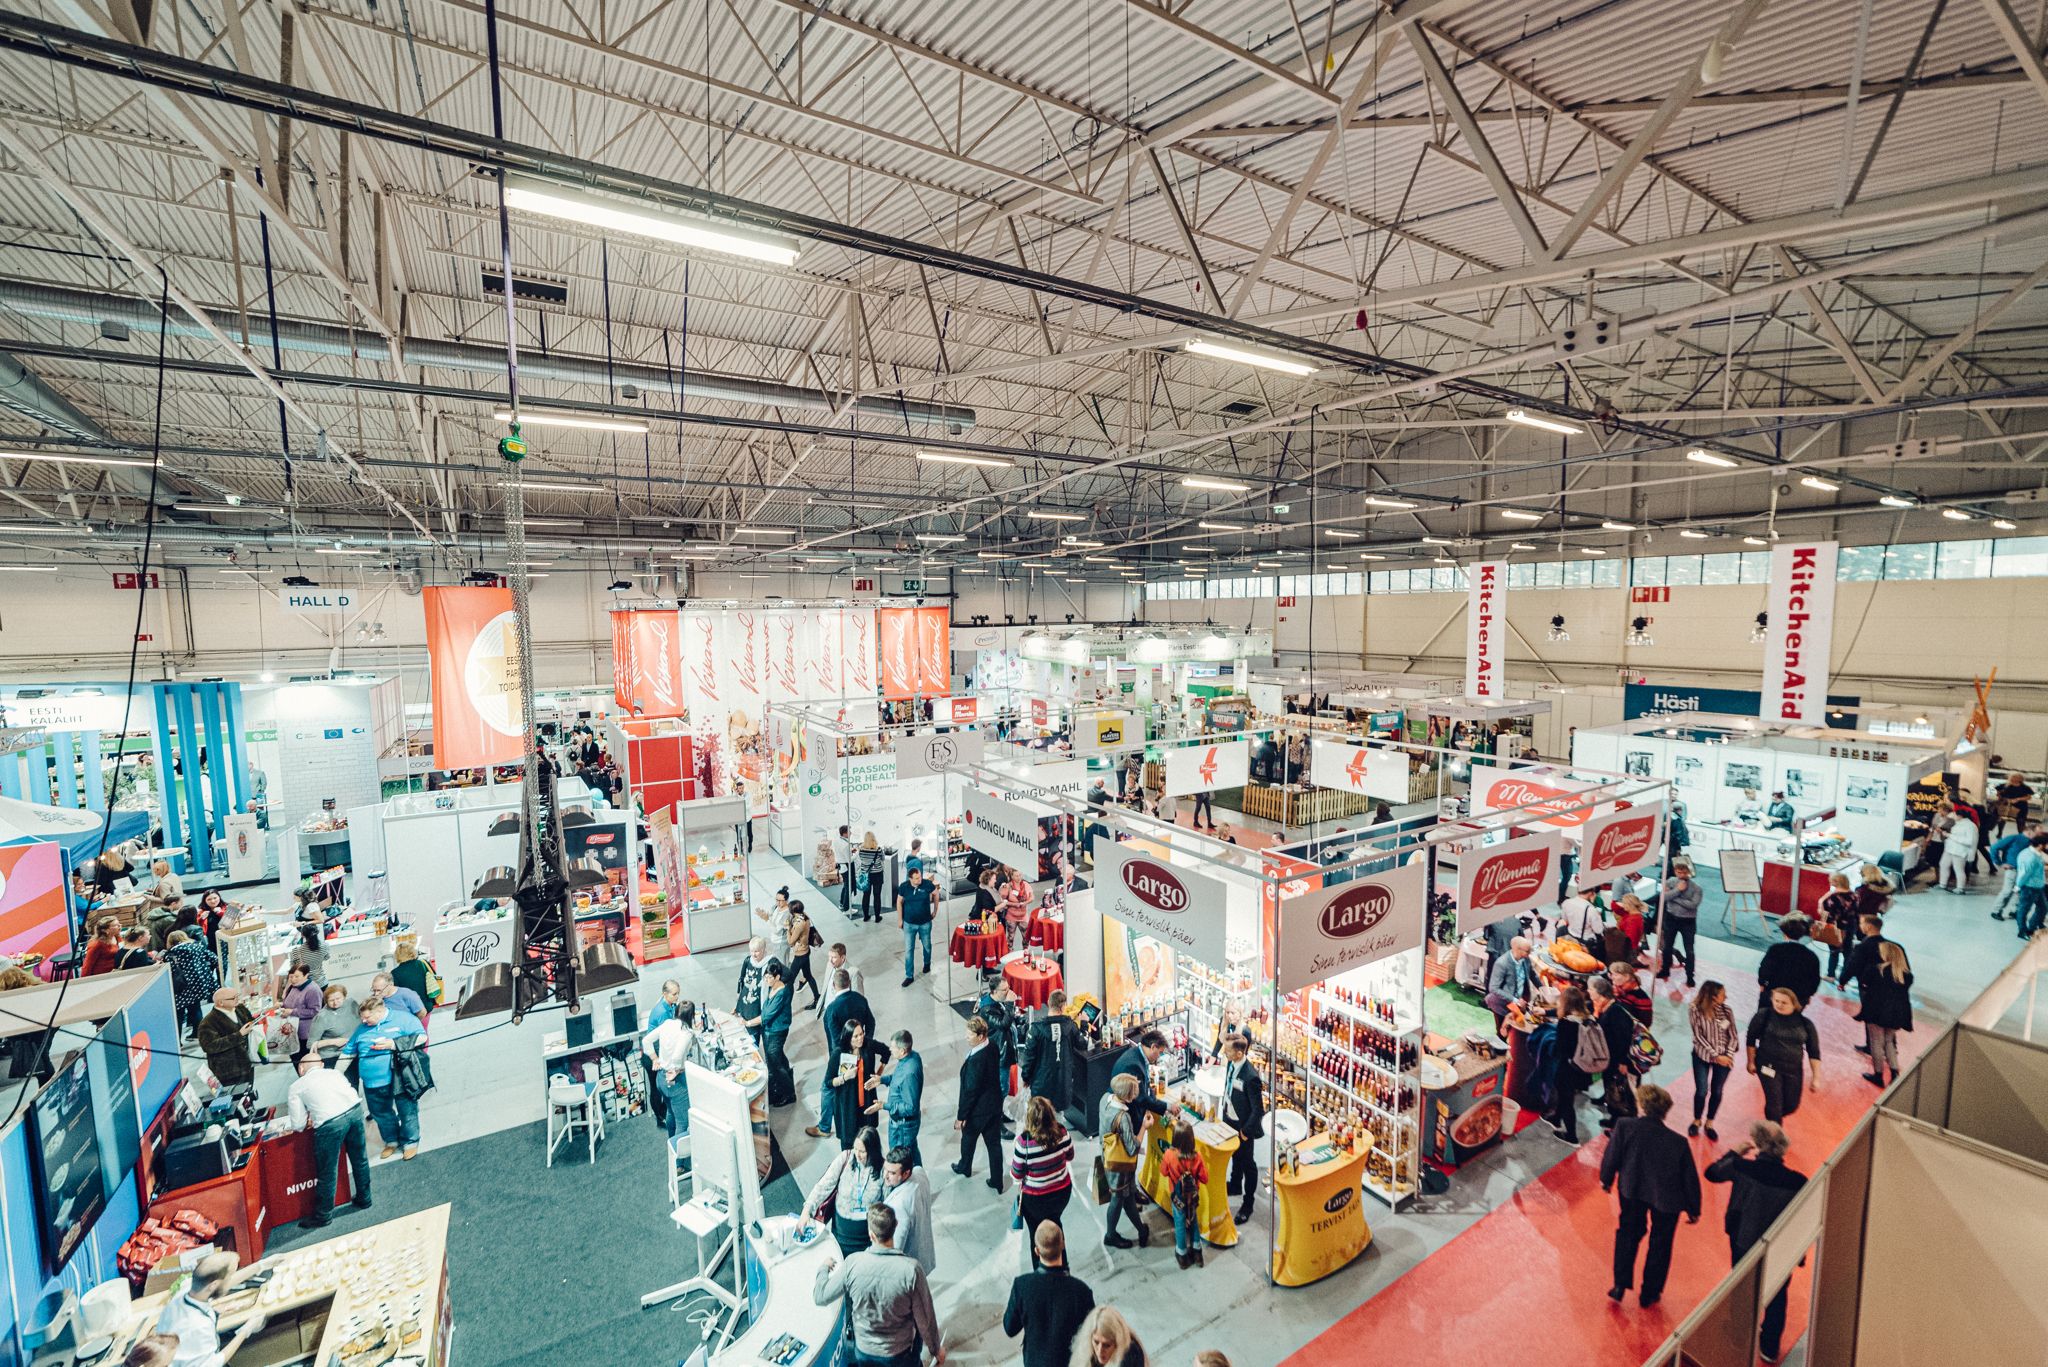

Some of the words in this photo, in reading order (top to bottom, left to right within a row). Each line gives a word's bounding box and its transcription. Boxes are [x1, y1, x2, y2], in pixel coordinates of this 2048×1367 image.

[289, 596, 332, 607] HALL
[338, 596, 350, 607] D
[1477, 565, 1495, 696] KitchenAid
[1781, 548, 1817, 720] KitchenAid
[29, 707, 62, 716] EESTI
[1654, 692, 1700, 711] Hästi
[931, 740, 952, 759] FS
[841, 768, 849, 776] A
[852, 763, 896, 775] PASSION
[841, 777, 861, 786] FOR
[865, 771, 897, 782] HEALT
[841, 783, 873, 794] FOOD!
[1050, 782, 1083, 795] MAHL
[976, 815, 1005, 838] RÕNGU
[1007, 830, 1033, 852] MAHL
[1600, 824, 1650, 855] Mamma
[1127, 863, 1185, 908] Largo
[1481, 858, 1542, 892] Mamma
[1328, 894, 1389, 931] Largo
[452, 931, 500, 967] Leibur
